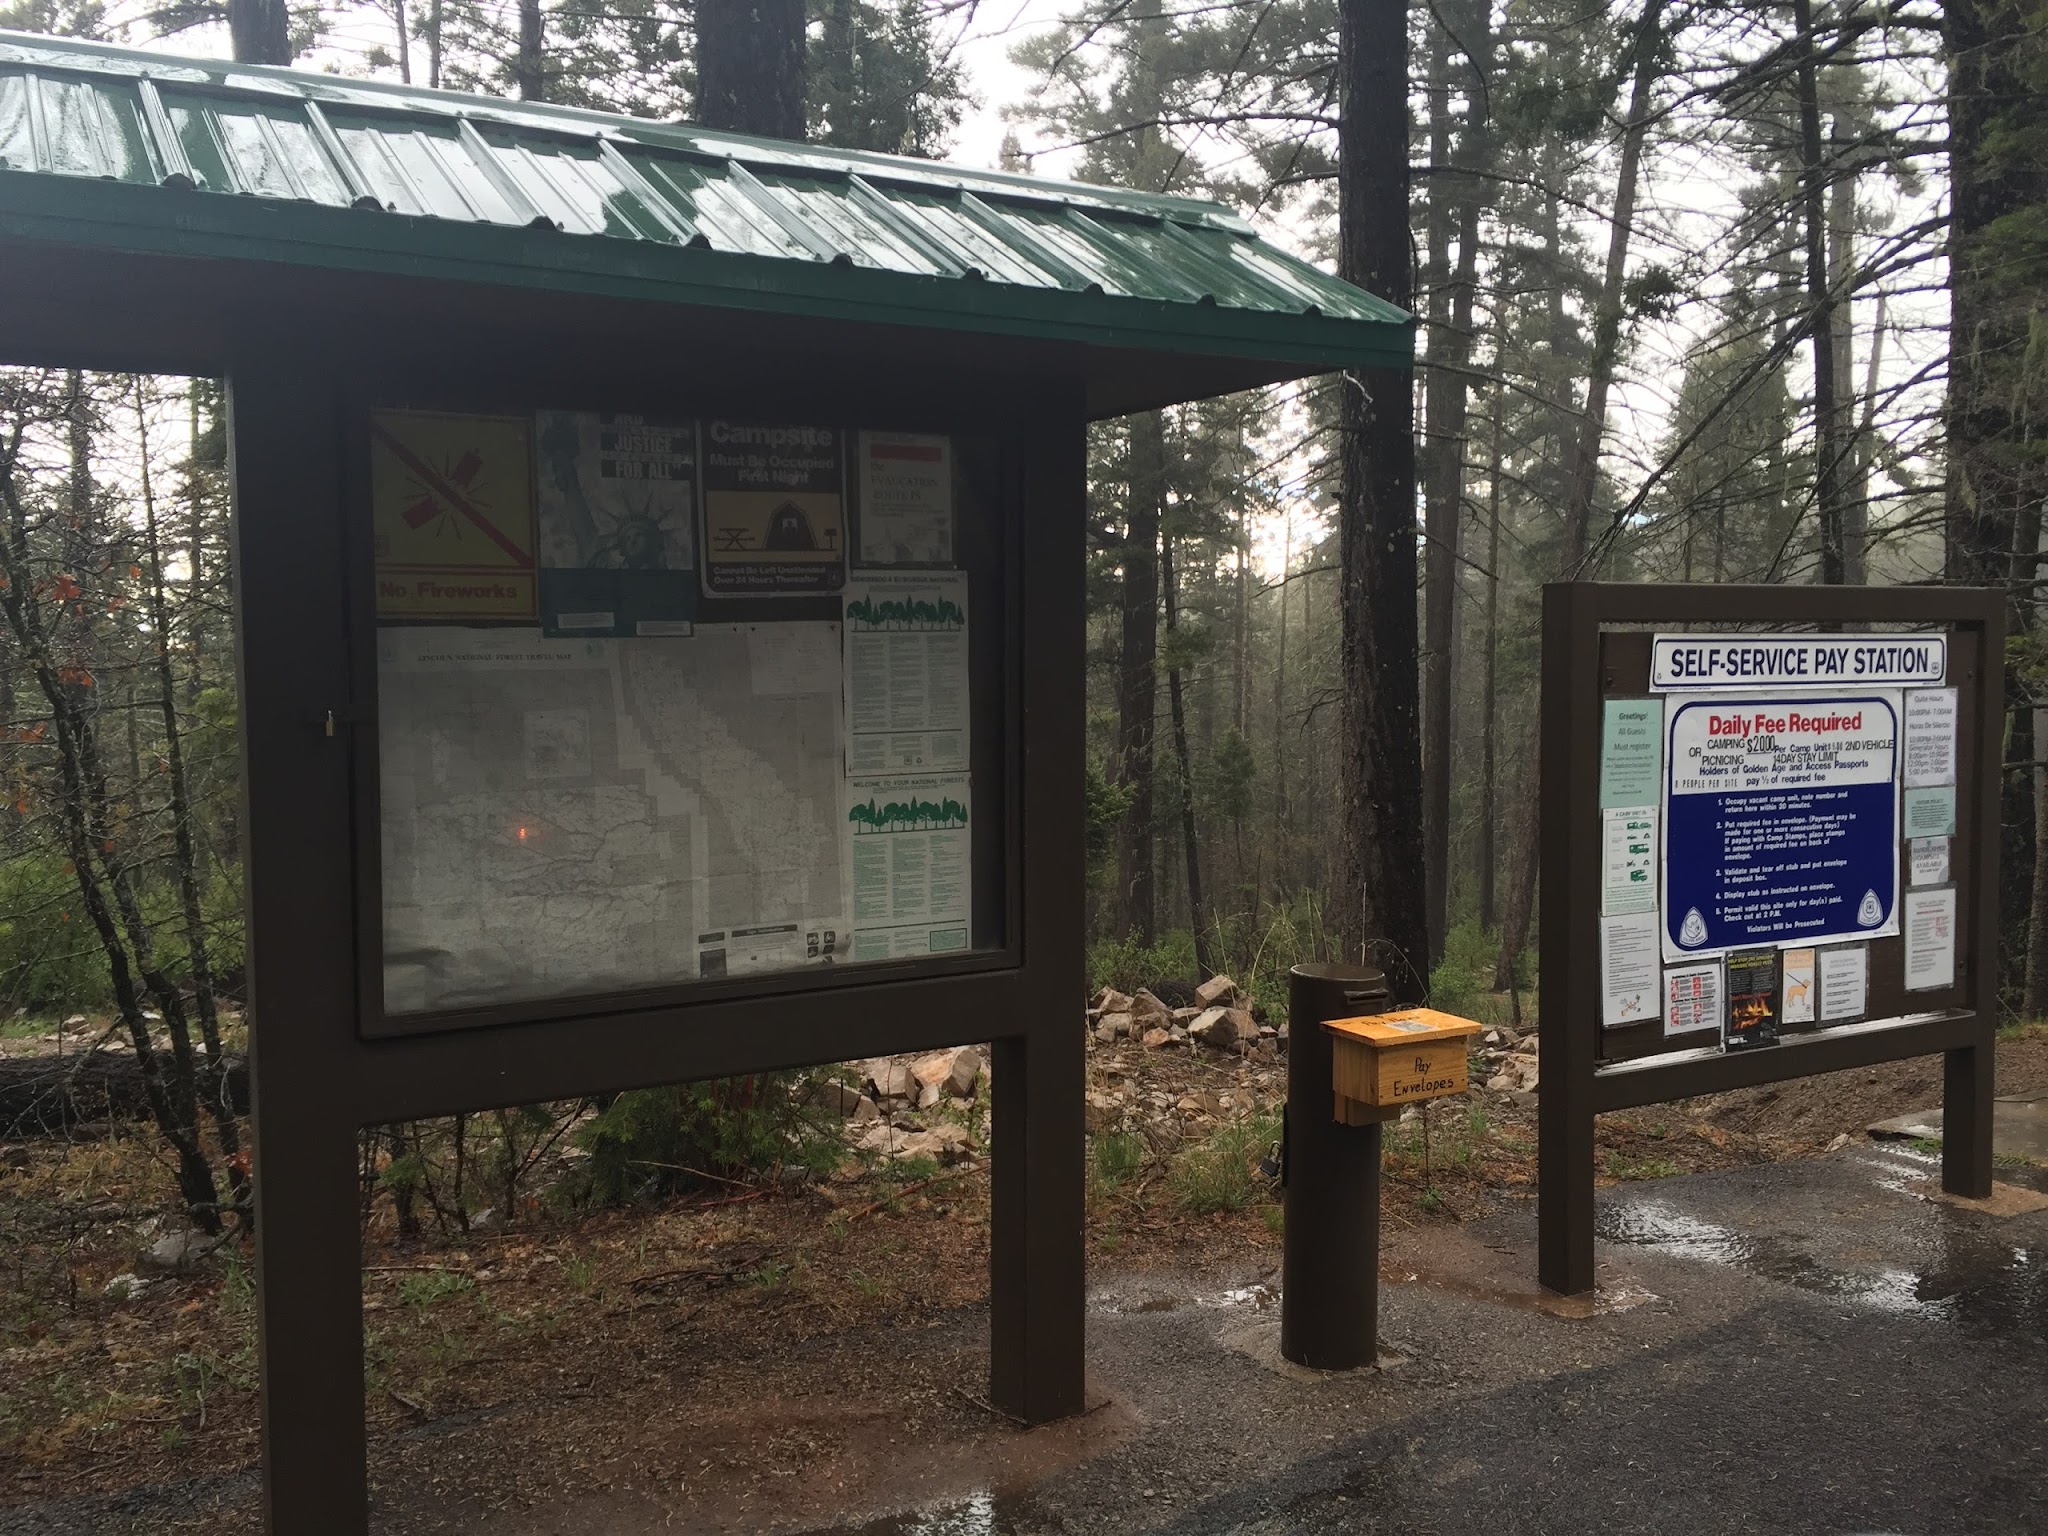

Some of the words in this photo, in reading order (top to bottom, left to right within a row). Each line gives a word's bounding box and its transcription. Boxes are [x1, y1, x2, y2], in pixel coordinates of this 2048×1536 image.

[710, 420, 833, 449] Campsite
[614, 434, 672, 453] JUSTICE
[615, 461, 643, 478] FOR
[649, 462, 672, 479] ALL
[710, 454, 744, 468] Must
[746, 455, 766, 467] Be
[768, 455, 834, 470] Occupied
[737, 469, 769, 482] First
[773, 470, 809, 485] Night
[713, 566, 745, 575] Cannot
[760, 566, 776, 575] Left
[714, 575, 733, 584] Over
[735, 575, 746, 584] 24
[748, 575, 774, 584] Hours
[776, 575, 819, 585] Thereafter
[380, 582, 407, 599] No
[417, 581, 517, 599] Fireworks
[1670, 647, 1808, 677] SELF-SERVICE
[1814, 647, 1849, 675] PAY
[1854, 647, 1928, 674] STATION
[1709, 715, 1752, 738] Daily
[1755, 714, 1786, 734] Fee
[1789, 712, 1862, 735] Required
[1630, 743, 1651, 752] register
[1688, 747, 1701, 758] OR
[1707, 738, 1746, 749] CAMPING
[1774, 746, 1786, 754] Per
[1790, 744, 1811, 754] Camp
[1845, 741, 1861, 751] 2ND
[1861, 739, 1894, 749] VEHICLE
[1702, 755, 1744, 765] PICNICING
[1796, 753, 1818, 762] STAY
[1818, 751, 1839, 762] LIMIT
[1700, 766, 1729, 776] Holders
[1732, 765, 1740, 774] of
[1743, 764, 1769, 773] Golden
[1771, 763, 1786, 773] Age
[1789, 763, 1803, 771] and
[1805, 762, 1831, 770] Access
[1834, 760, 1869, 770] Passports
[1683, 779, 1706, 789] PEOPLE
[1725, 778, 1738, 787] SITE
[1746, 777, 1759, 787] pay
[1771, 775, 1779, 784] of
[1782, 774, 1811, 784] required
[1814, 773, 1826, 781] fee
[1749, 796, 1768, 804] vacant
[1737, 820, 1760, 828] required
[1781, 817, 1807, 825] envelope.
[1809, 815, 1835, 823] (Payment
[1790, 824, 1823, 832] consecutive
[1824, 821, 1840, 829] days)
[1731, 836, 1751, 844] paying
[1766, 834, 1783, 842] Camp
[1785, 832, 1808, 841] Stamps,
[1732, 844, 1754, 852] amount
[1764, 841, 1787, 850] required
[1789, 840, 1798, 848] fee
[1724, 853, 1752, 861] envelope.
[1724, 868, 1748, 876] Validate
[1812, 861, 1822, 869] put
[1823, 859, 1847, 868] envelope
[1732, 875, 1753, 883] deposit
[1724, 890, 1745, 899] Display
[1747, 889, 1760, 897] stub
[1771, 885, 1799, 895] instructed
[1809, 883, 1835, 891] envelope.
[1724, 906, 1743, 914] Permit
[1745, 904, 1759, 912] valid
[1786, 901, 1797, 909] only
[1809, 896, 1827, 906] day(s)
[1829, 895, 1843, 904] paid.
[1724, 914, 1742, 922] Check
[1744, 912, 1754, 920] out
[1747, 925, 1771, 933] Violators
[1794, 918, 1825, 928] Prosecuted
[1415, 1057, 1431, 1075] Pay
[1394, 1077, 1453, 1096] Envelopes
